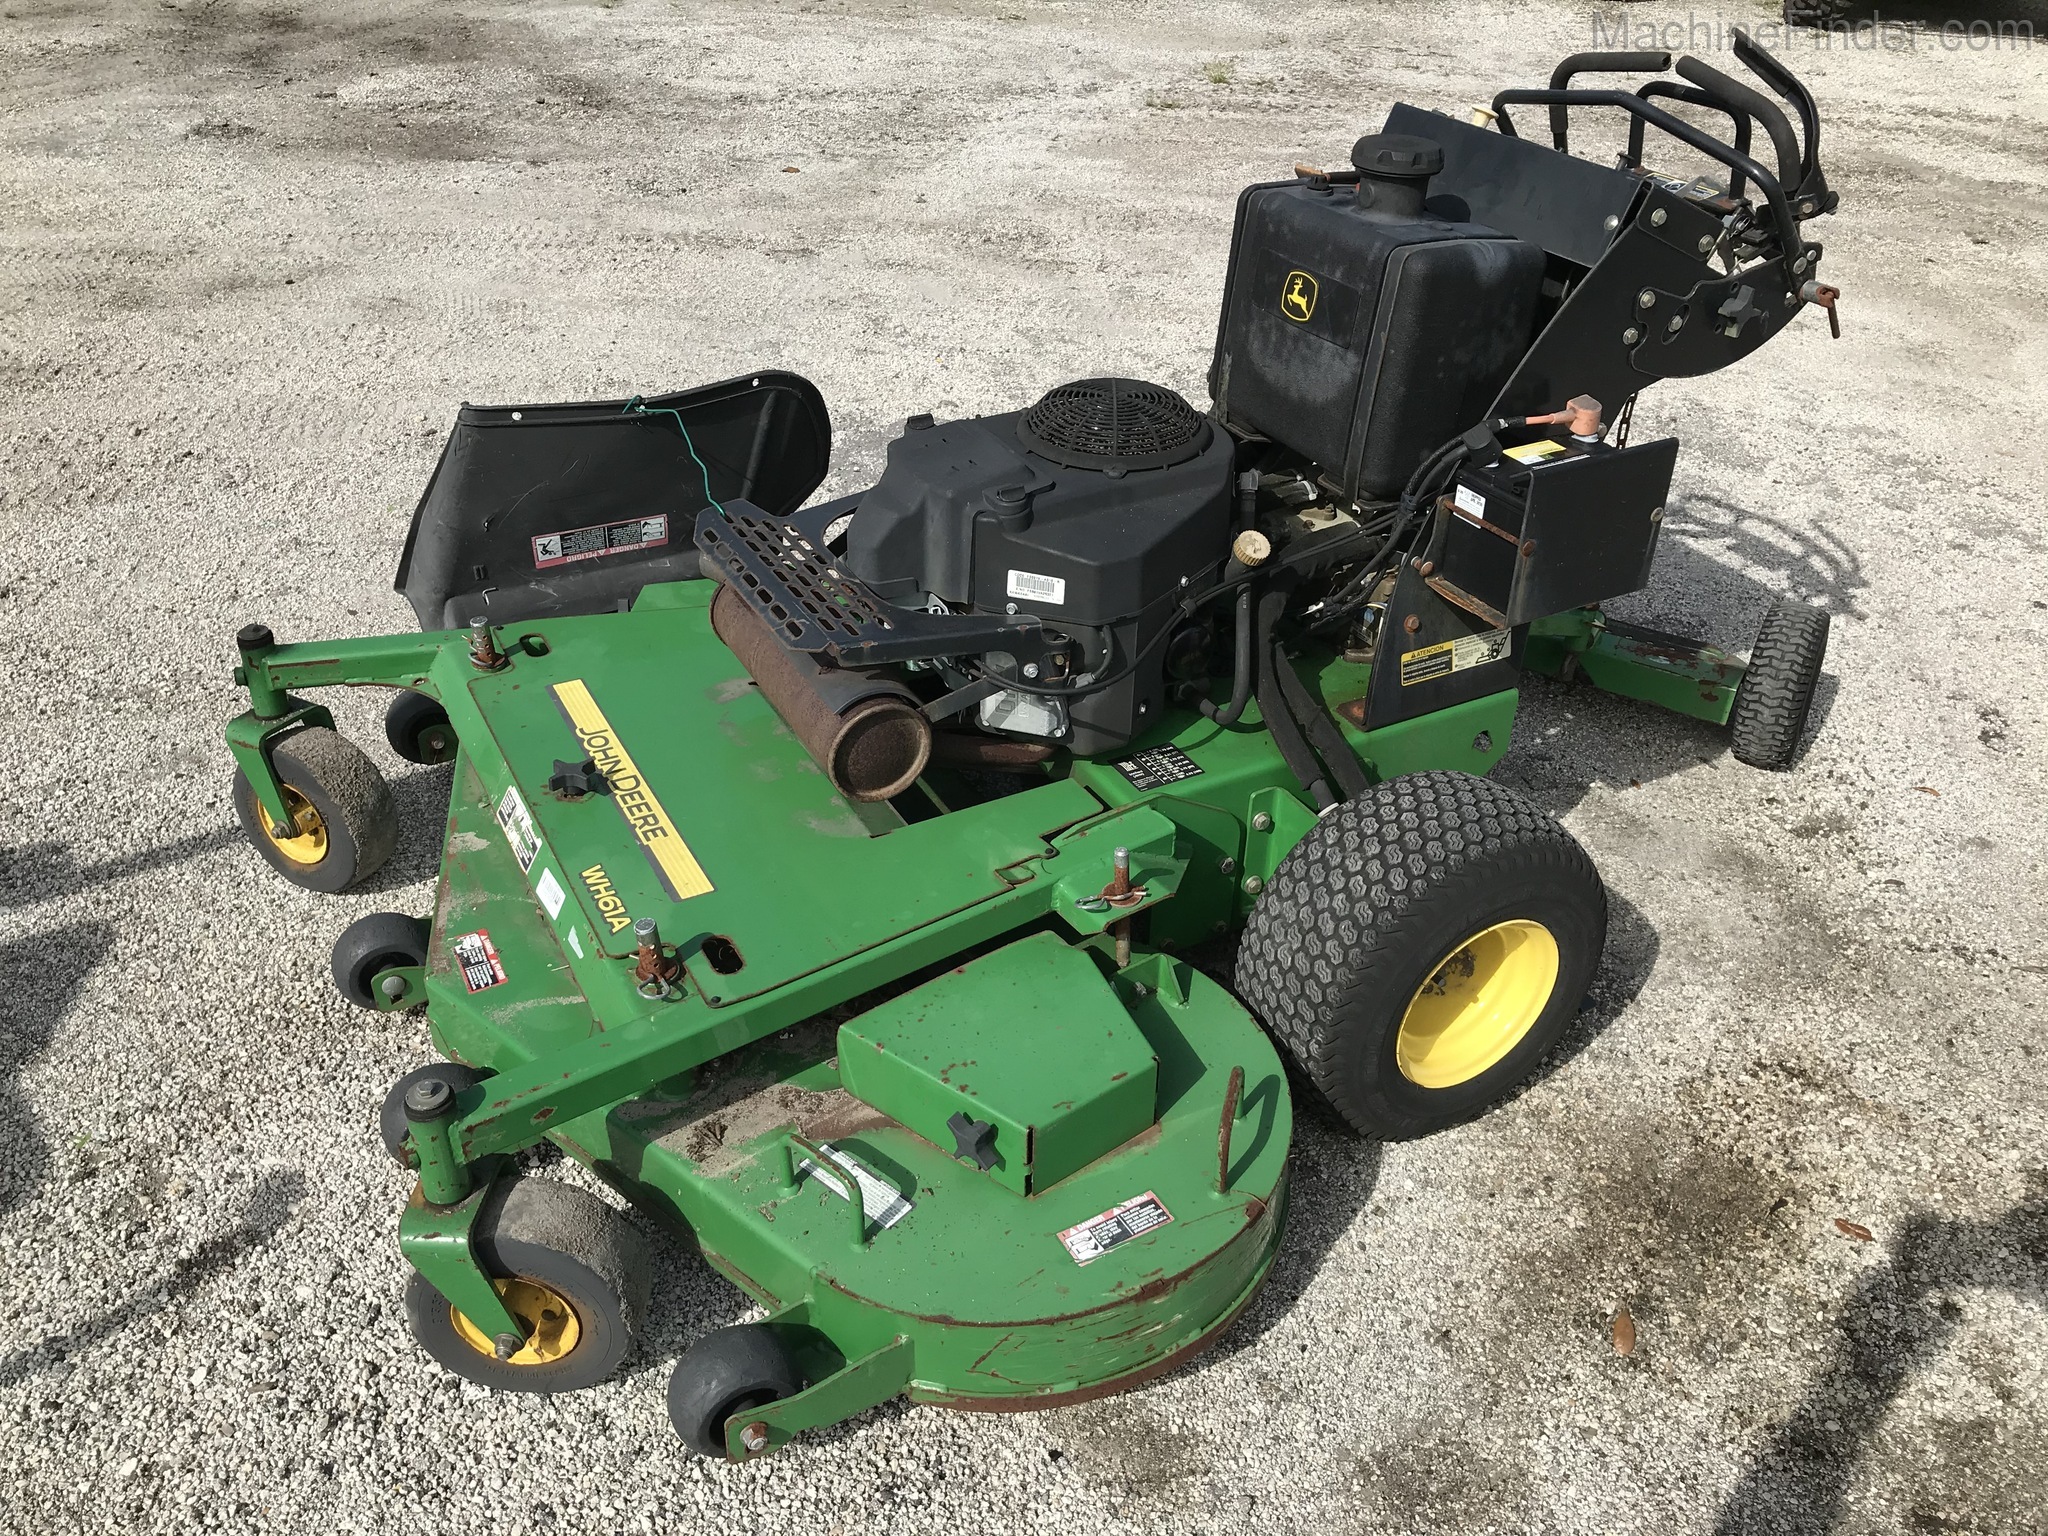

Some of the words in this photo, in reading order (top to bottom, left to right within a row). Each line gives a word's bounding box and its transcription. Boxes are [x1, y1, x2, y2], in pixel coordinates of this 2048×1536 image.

[567, 551, 597, 561] PELIGRO
[610, 544, 638, 553] DANGER
[578, 728, 627, 775] JOHN
[613, 774, 668, 842] DEERE
[581, 865, 631, 933] WH61A
[1077, 1215, 1105, 1230] DANGER
